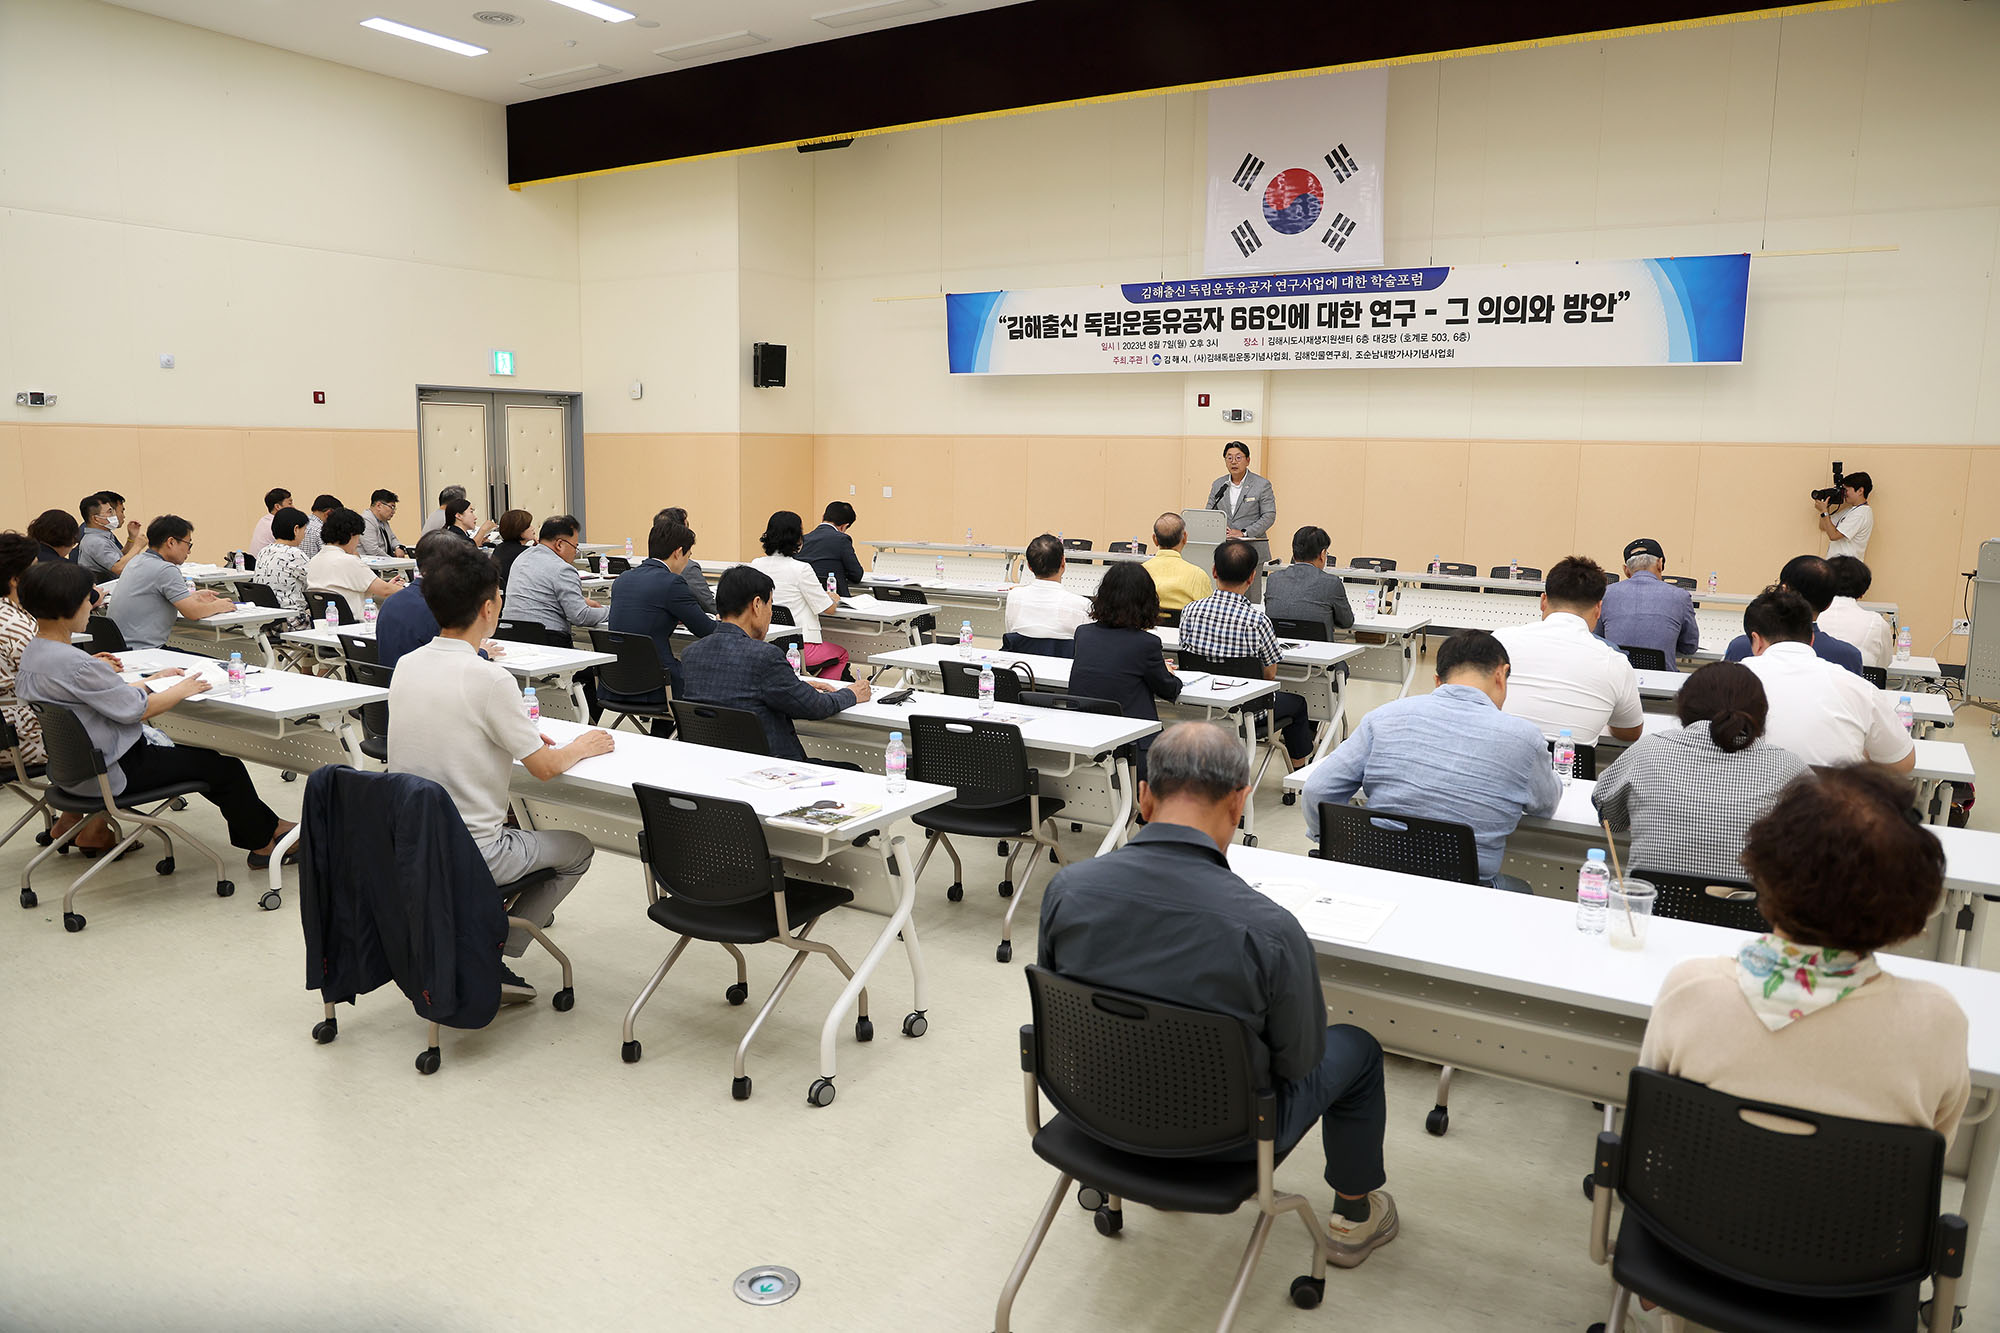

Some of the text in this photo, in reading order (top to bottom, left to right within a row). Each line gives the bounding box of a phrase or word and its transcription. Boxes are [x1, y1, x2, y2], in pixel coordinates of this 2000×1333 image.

[1141, 272, 1423, 300] 김해출신 독립운동유공자 연구사업에 대한 학술포럼
[1084, 306, 1224, 337] 독립운동유공자
[1231, 303, 1309, 331] 66인에
[1317, 300, 1363, 329] 대한
[1369, 299, 1416, 328] 연구
[1445, 298, 1469, 325] 그
[1477, 294, 1555, 324] 의의와
[1101, 338, 1219, 351] 일시 2023년 8월 7일(월) 오후 3시
[1243, 337, 1259, 347] 장소
[1267, 334, 1353, 346] 김해시도시재생지원센터
[1355, 334, 1370, 344] 6층
[1372, 333, 1397, 344] 대강당
[1400, 332, 1429, 343] (호계로
[1453, 332, 1471, 343] 6층)
